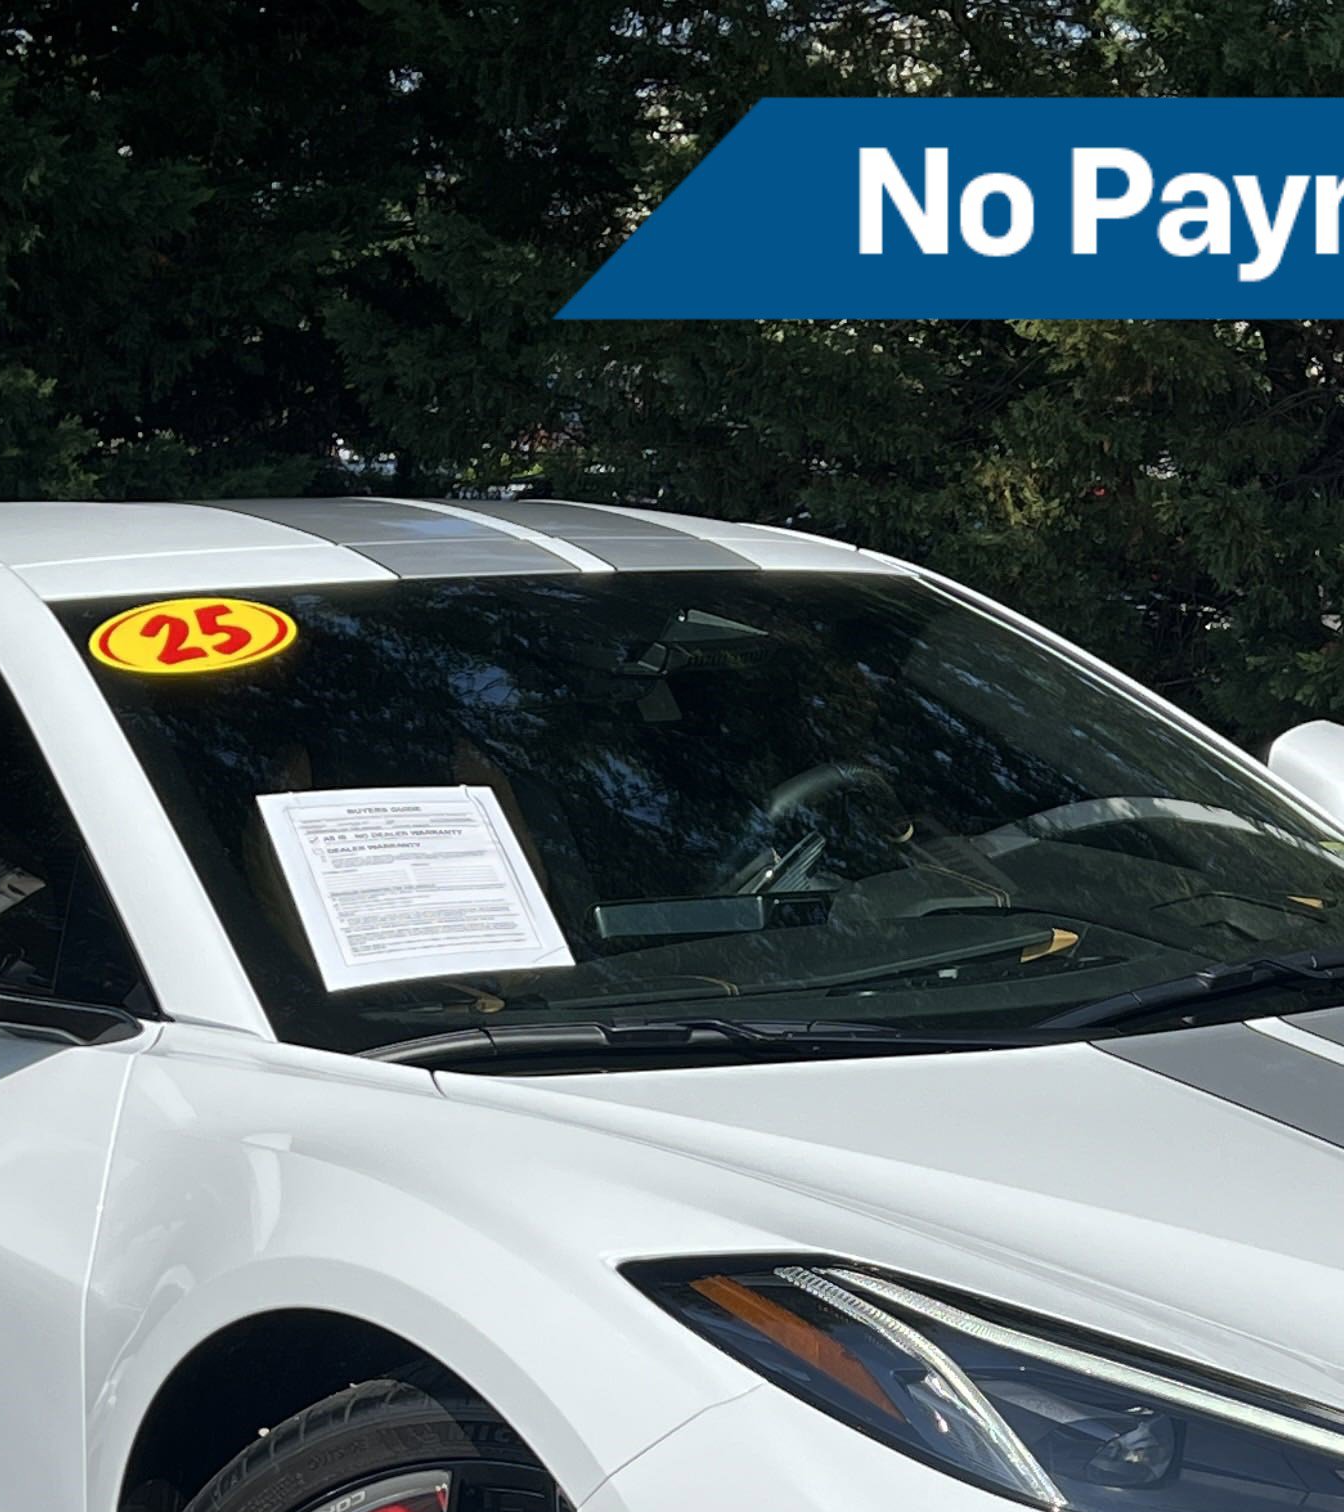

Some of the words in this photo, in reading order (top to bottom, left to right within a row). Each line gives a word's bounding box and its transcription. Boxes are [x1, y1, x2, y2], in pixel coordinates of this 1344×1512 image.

[140, 604, 252, 665] 25
[346, 806, 388, 815] BUYERS
[390, 805, 422, 813] GUIDE
[371, 830, 409, 839] DEALER
[410, 828, 463, 837] WARRANTY
[327, 845, 366, 855] DEALER
[367, 842, 421, 851] WARRANTY
